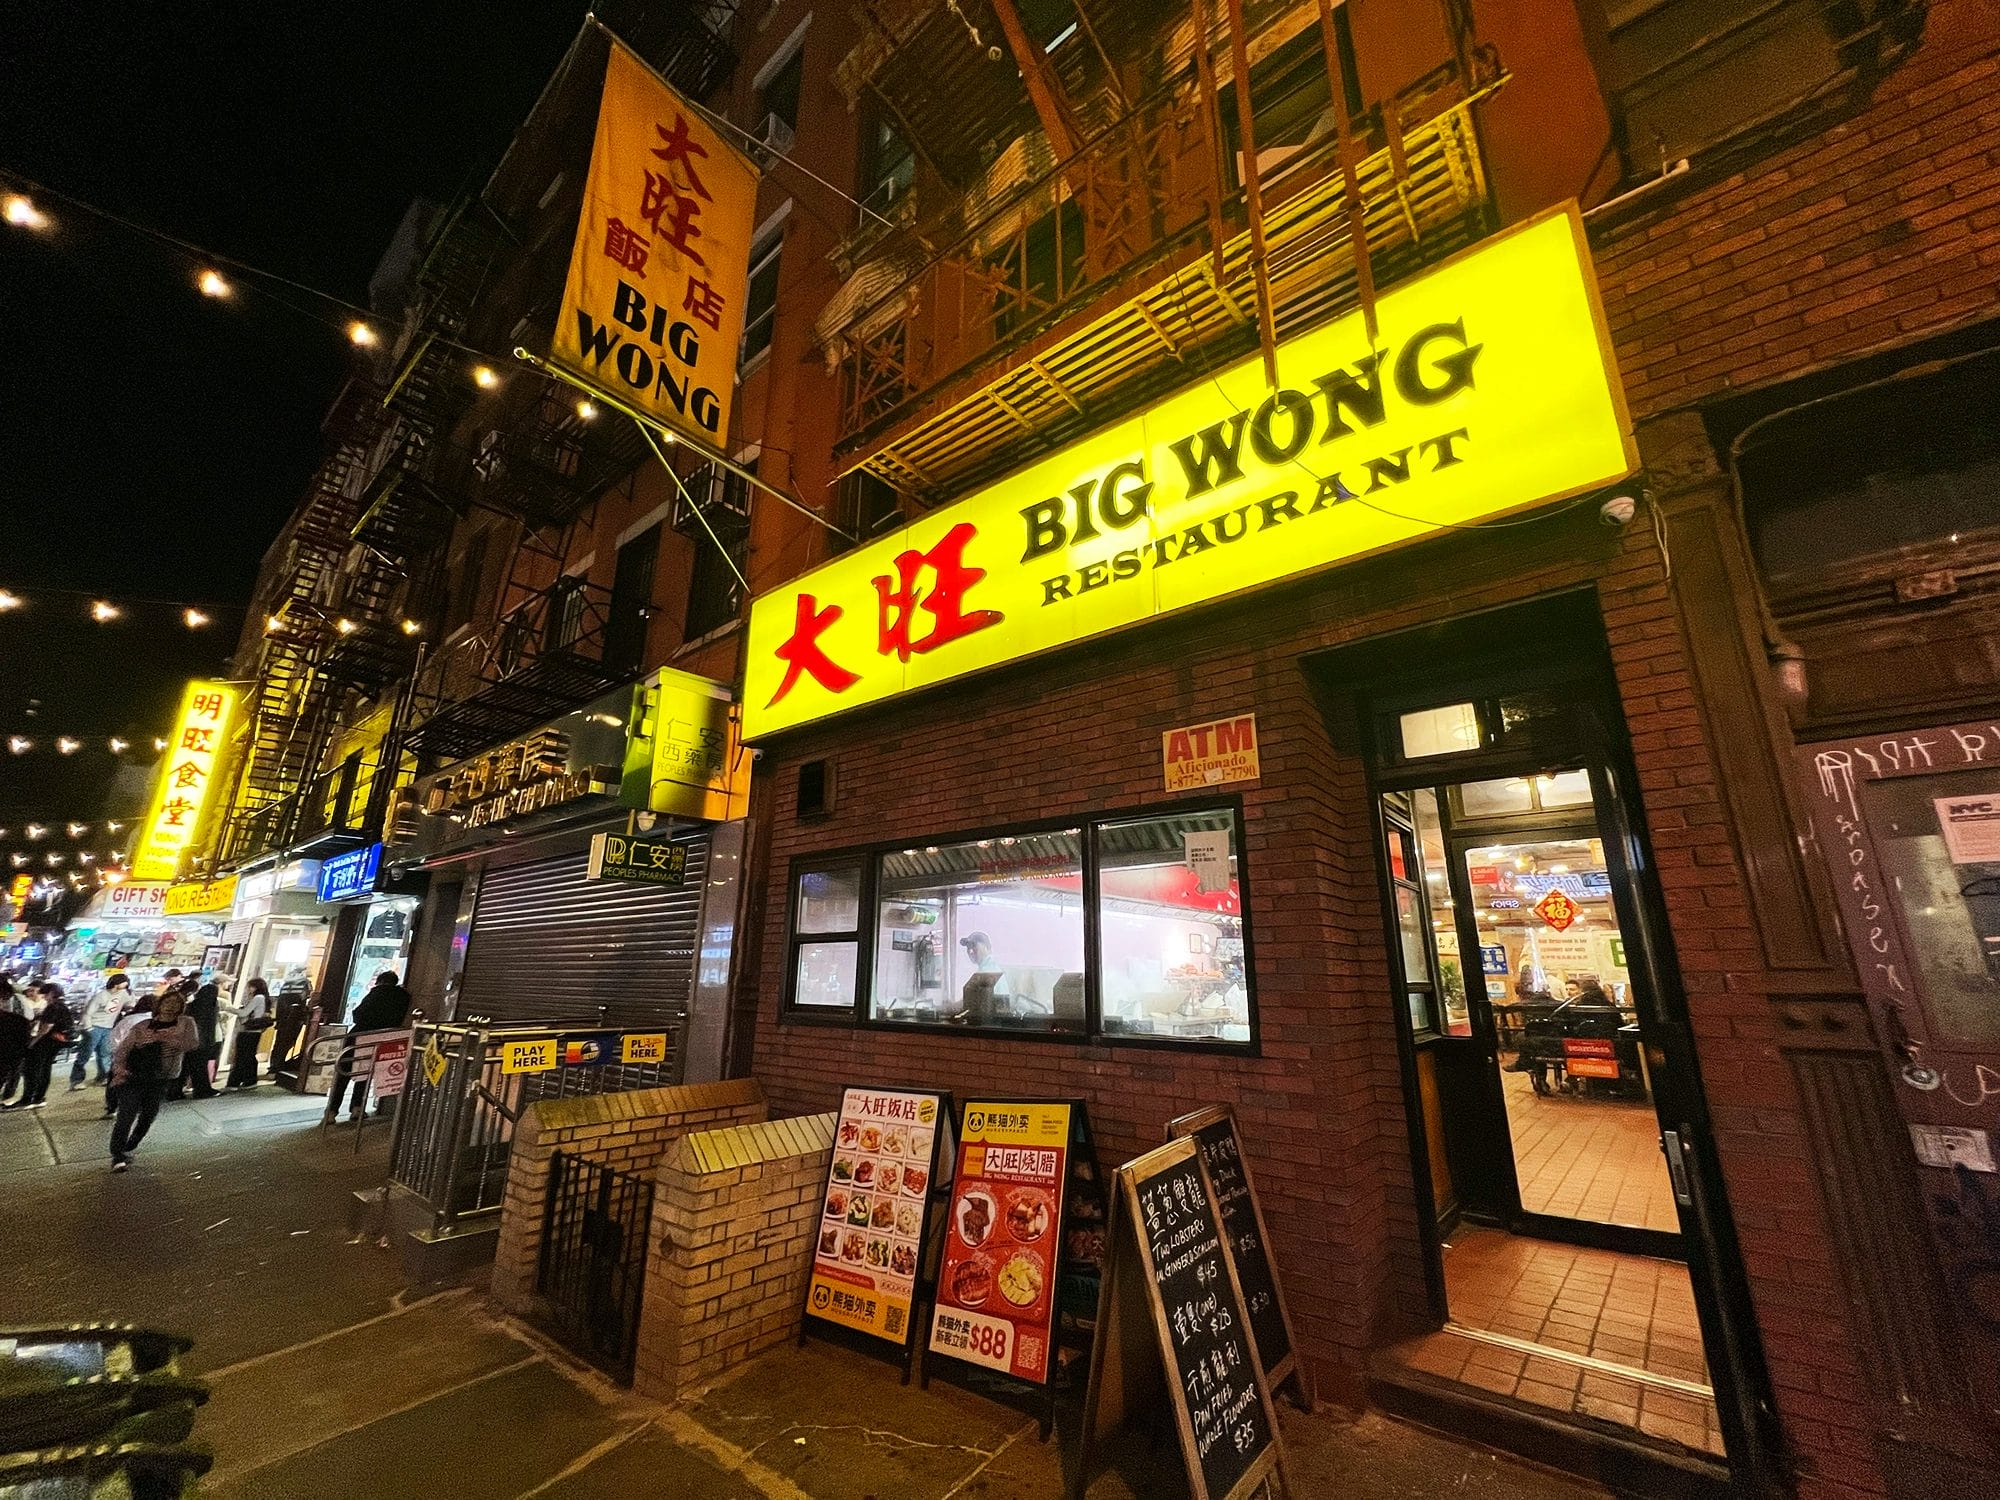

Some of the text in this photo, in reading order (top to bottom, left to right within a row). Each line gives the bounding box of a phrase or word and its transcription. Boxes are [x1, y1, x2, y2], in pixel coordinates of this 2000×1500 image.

[641, 111, 713, 267] 大旺
[613, 278, 699, 368] BIG
[577, 309, 720, 432] WONG
[1019, 315, 1483, 564] BIG WONG
[1040, 427, 1472, 607] RESTAURANT
[764, 521, 1004, 711] 大旺
[1167, 717, 1253, 764] ATM
[1175, 754, 1246, 777] Aficionado
[602, 866, 683, 883] PEOPLES PHARMACY
[113, 887, 167, 903] GIFT SH
[513, 1046, 545, 1057] PLAY
[859, 1096, 918, 1121] 大旺饭店
[987, 1113, 1030, 1129] 熊猫外卖
[986, 1149, 1055, 1174] 大旺烧腊
[1197, 1260, 1218, 1288] $45
[832, 1290, 877, 1319] 熊猫外卖
[1210, 1307, 1231, 1338] $28
[969, 1322, 1006, 1360] $88
[1234, 1420, 1255, 1453] $35
